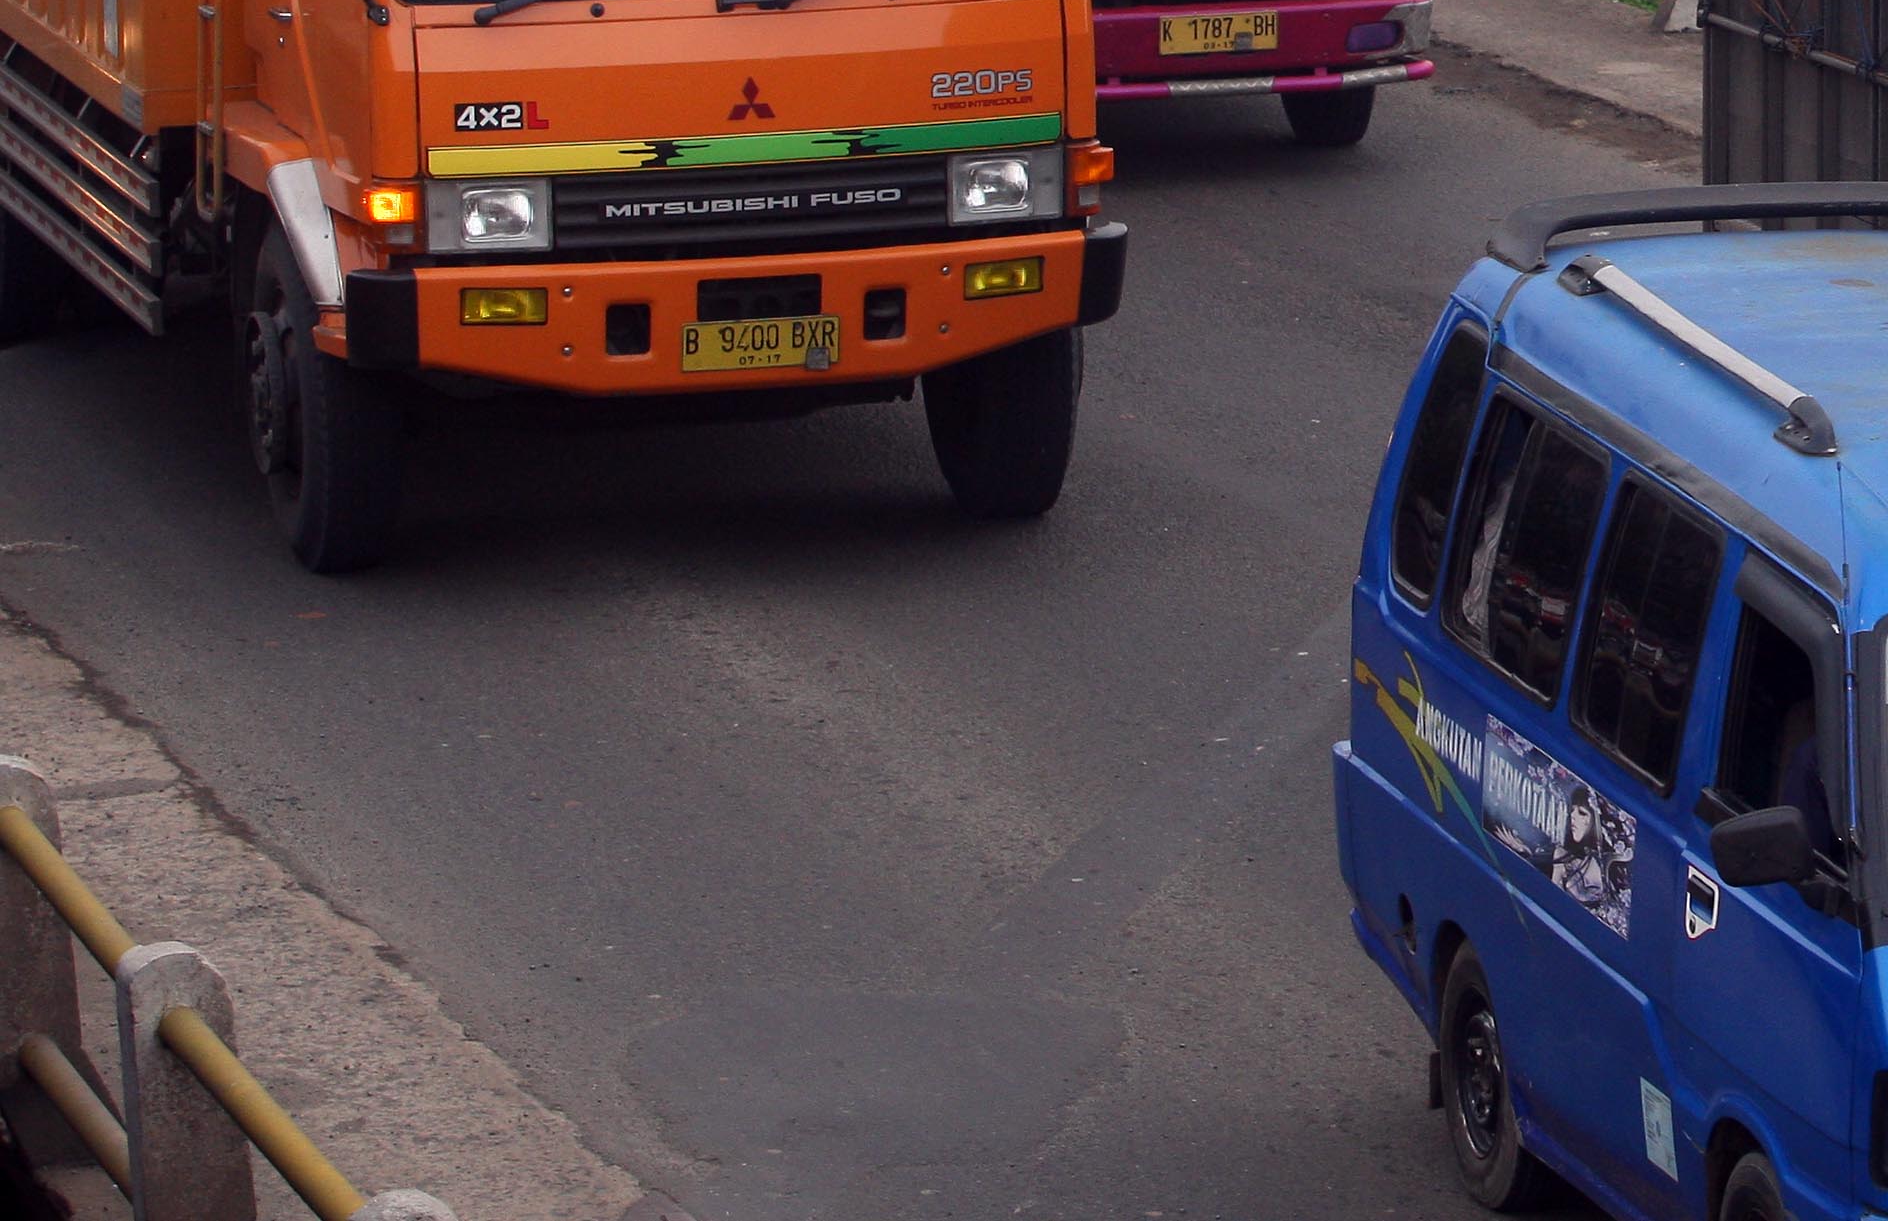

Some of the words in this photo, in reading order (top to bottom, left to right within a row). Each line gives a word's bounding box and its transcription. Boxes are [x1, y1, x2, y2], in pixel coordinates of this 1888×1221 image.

[1162, 20, 1173, 42] K
[1190, 17, 1233, 40] 1787
[1253, 14, 1275, 36] BH
[931, 69, 1033, 98] 220PS
[605, 195, 799, 217] MITSUBISHI
[810, 188, 901, 207] FUSO
[685, 328, 699, 355] B
[718, 323, 779, 353] 9400
[791, 320, 836, 349] BXR
[1416, 697, 1483, 782] ANGKUTAN
